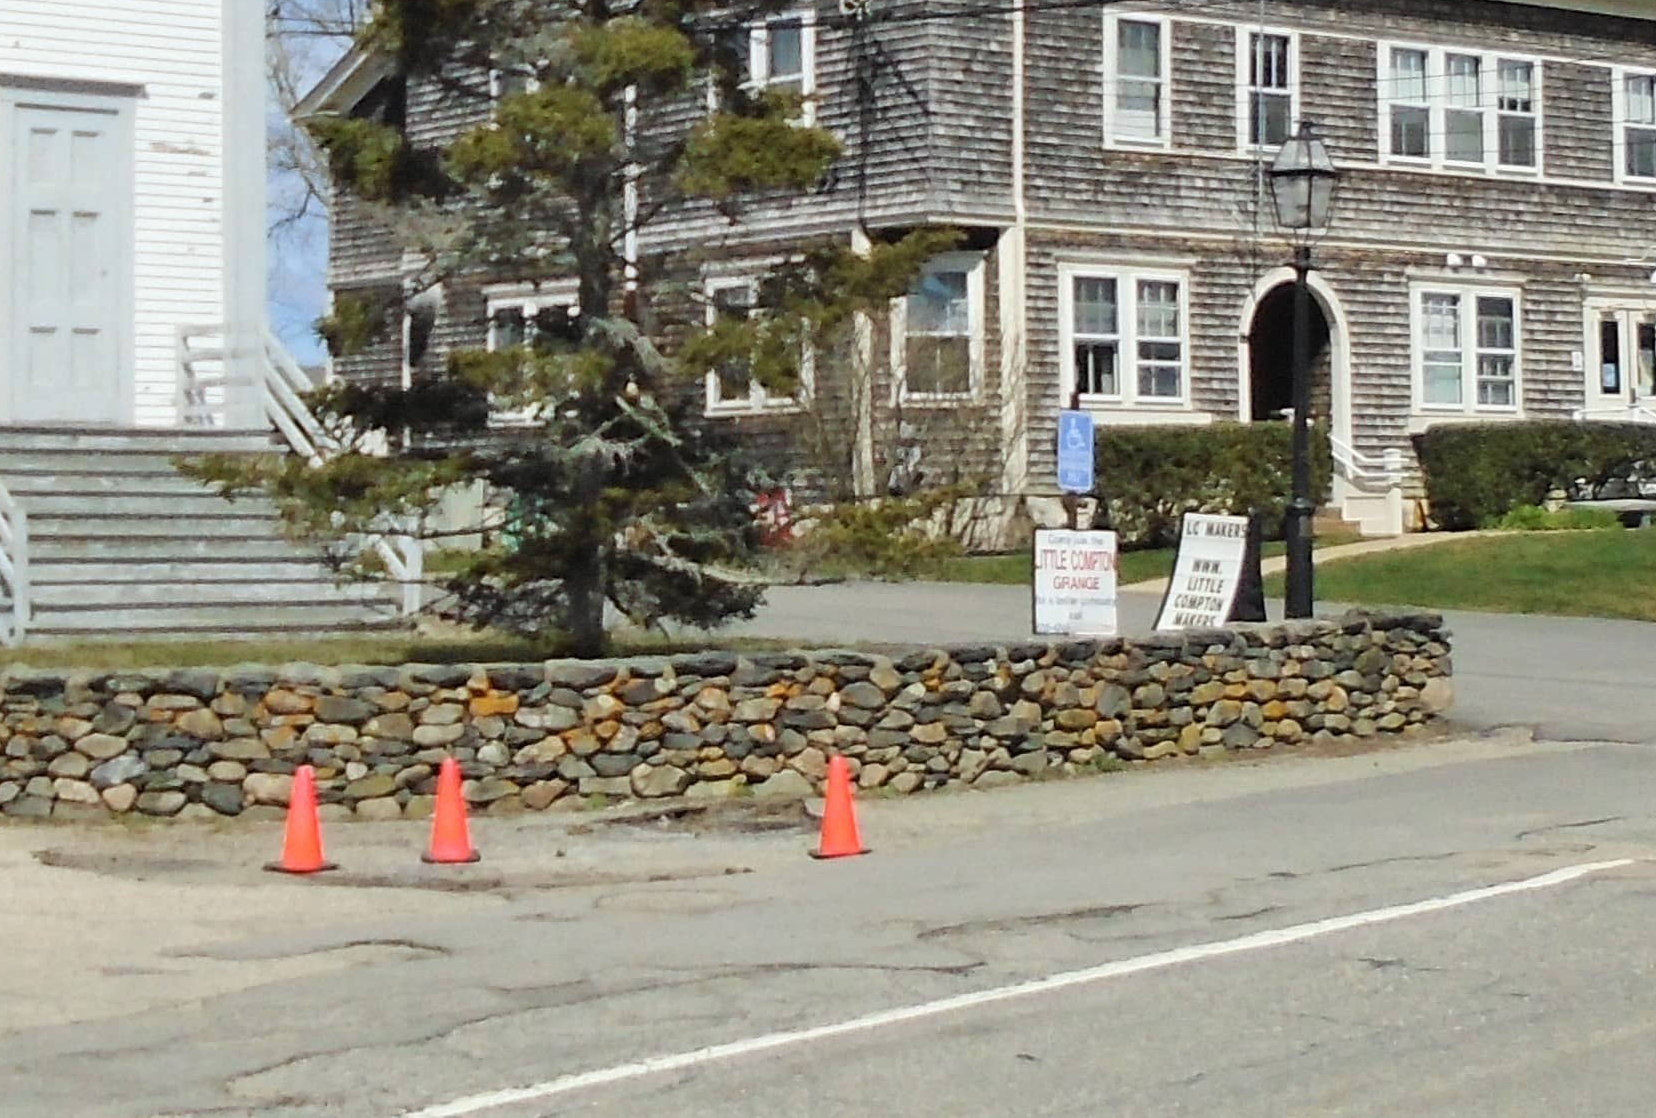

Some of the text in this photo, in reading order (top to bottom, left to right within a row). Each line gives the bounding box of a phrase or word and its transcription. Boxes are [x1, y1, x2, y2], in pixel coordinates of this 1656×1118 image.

[1186, 521, 1247, 538] LC MAKERS
[1054, 576, 1100, 590] GRANGE
[1187, 577, 1224, 593] LITTLE
[1174, 594, 1224, 611] COMPTON
[1173, 611, 1216, 626] MAKERS
